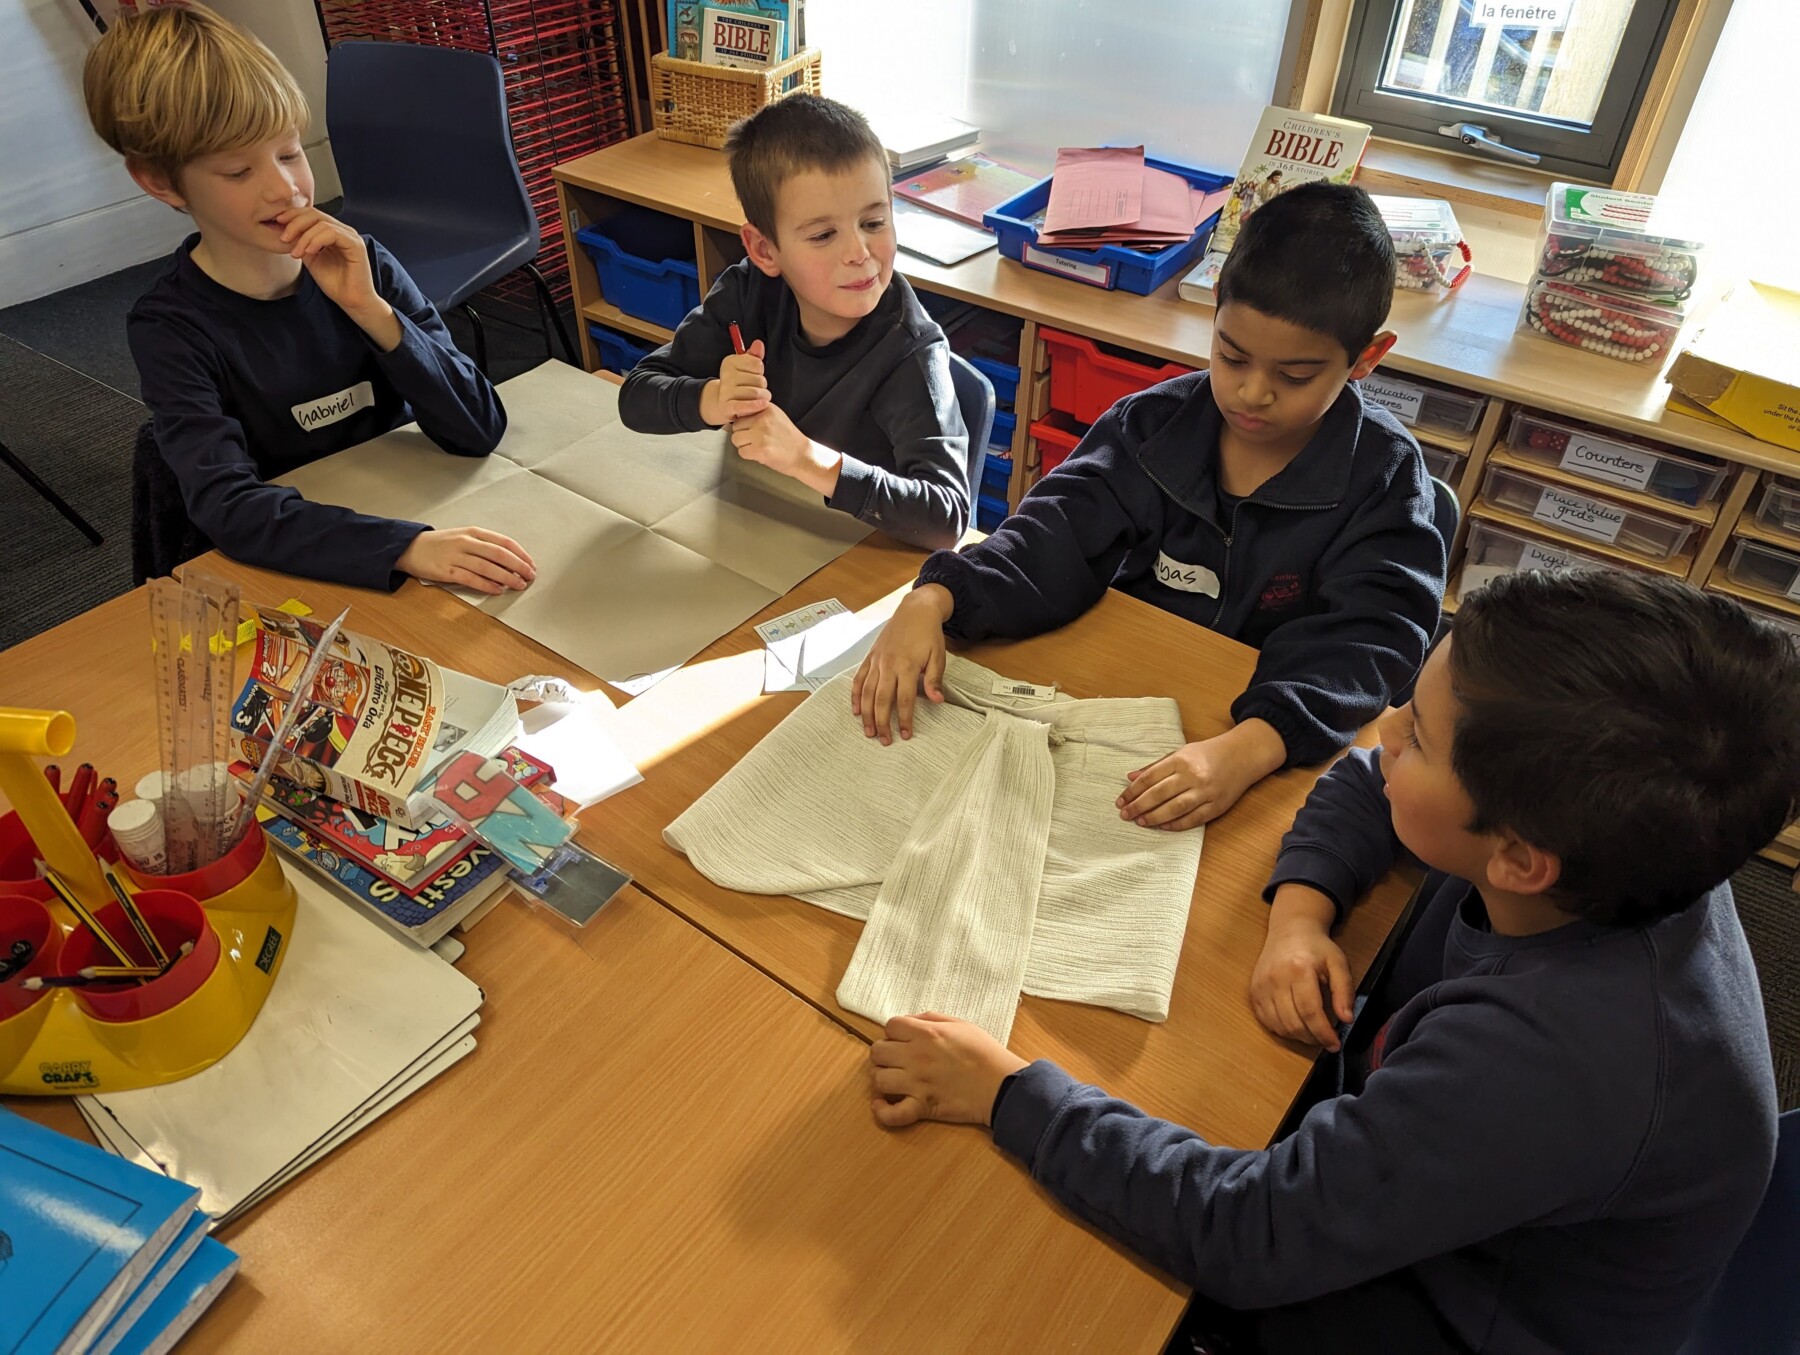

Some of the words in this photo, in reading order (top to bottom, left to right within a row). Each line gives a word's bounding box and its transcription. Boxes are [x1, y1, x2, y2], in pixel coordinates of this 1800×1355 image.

[1482, 4, 1495, 17] la
[1500, 4, 1557, 20] fenêtre
[713, 22, 771, 55] BIBLE
[1283, 121, 1341, 138] CHILDREN'S
[1264, 129, 1344, 169] BIBLE
[1268, 160, 1276, 168] IN
[1277, 163, 1294, 172] 365
[1295, 166, 1325, 177] STORIES
[1056, 258, 1077, 270] Tutoring
[1360, 382, 1418, 404] ltiplication
[1575, 445, 1645, 473] Counters
[1545, 492, 1582, 509] Place
[1586, 502, 1621, 524] Value
[1552, 506, 1595, 523] grids
[263, 633, 271, 659] Volume
[263, 662, 277, 677] 2
[243, 684, 258, 708] Volume
[371, 664, 384, 705] Eiichiro
[236, 711, 252, 726] 3
[362, 706, 379, 729] Oda
[421, 706, 436, 735] EAST
[407, 735, 427, 769] BLUE
[363, 786, 380, 817] PIECE
[377, 793, 393, 819] ONE
[39, 1061, 91, 1073] CARRY
[42, 1071, 94, 1084] CRAFT
